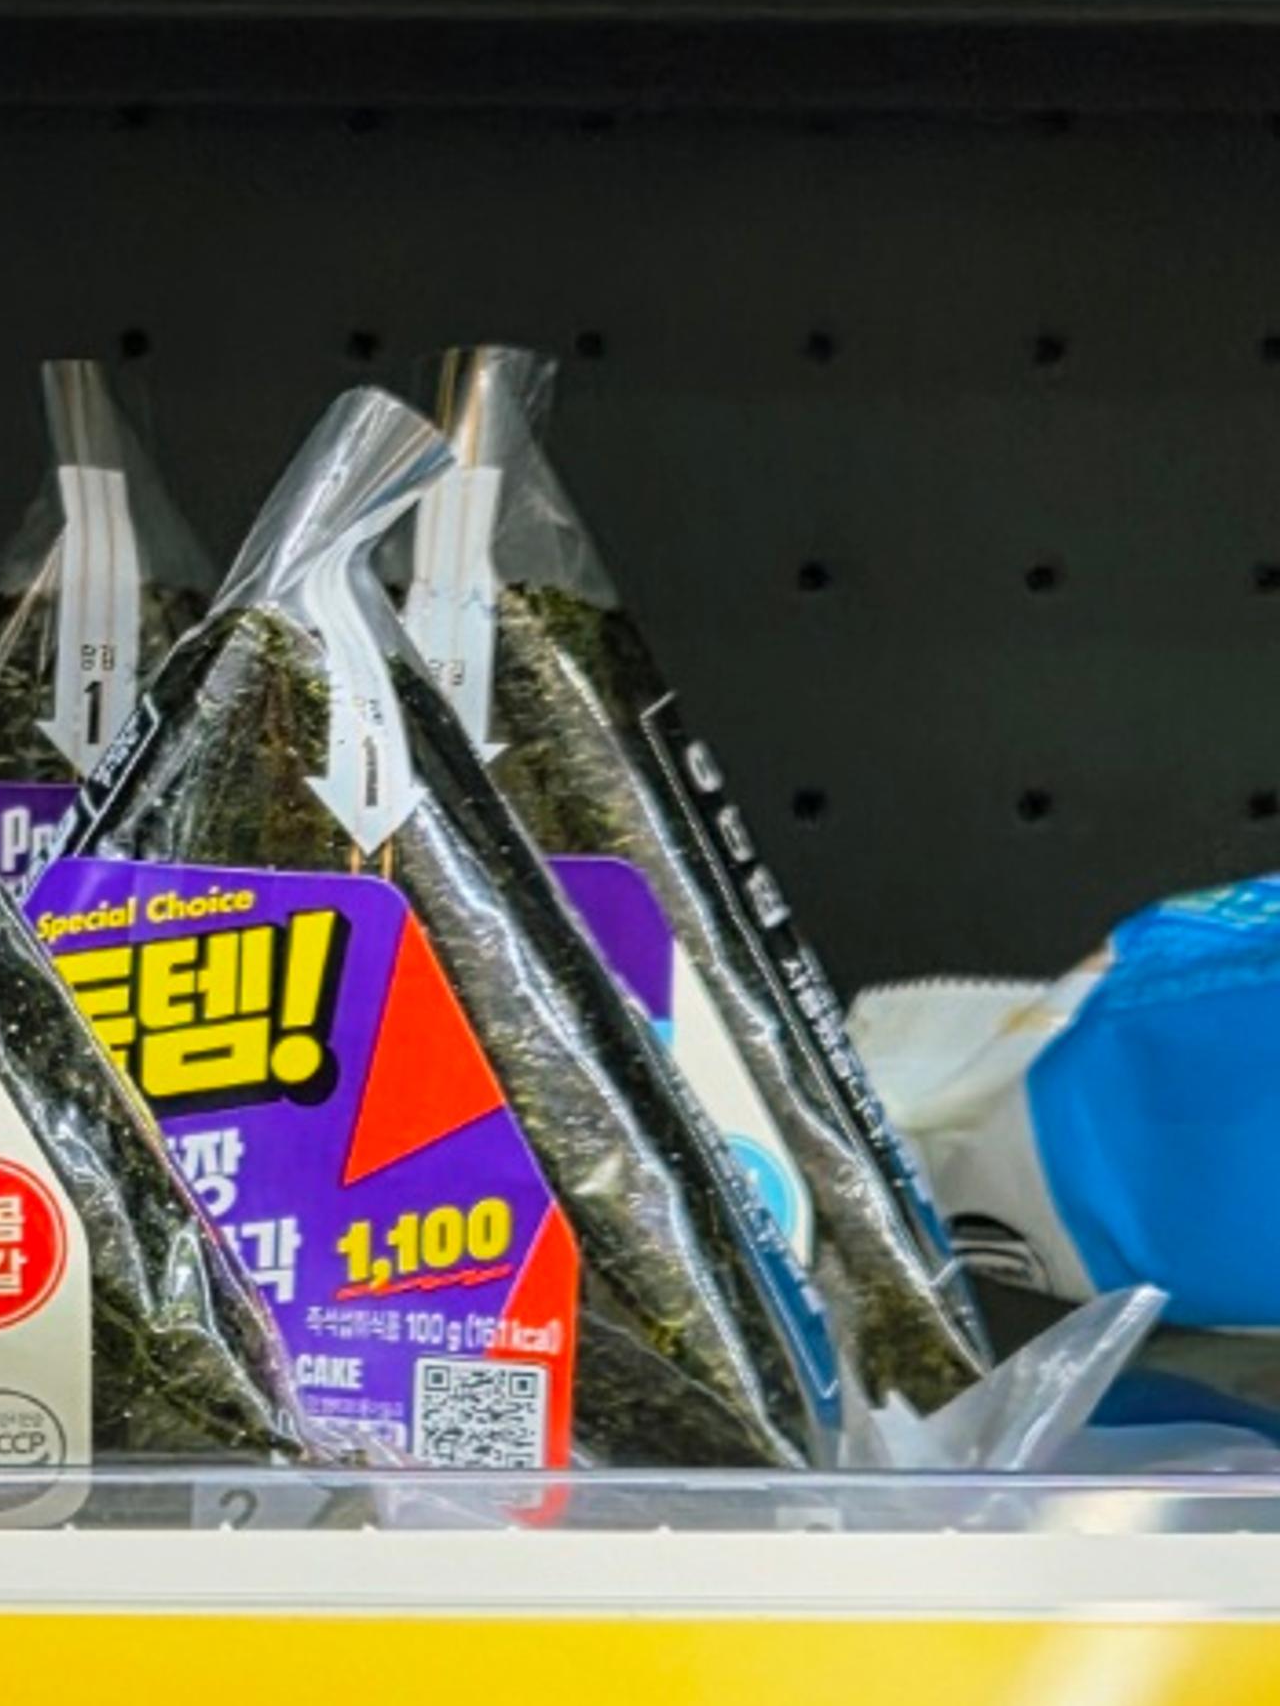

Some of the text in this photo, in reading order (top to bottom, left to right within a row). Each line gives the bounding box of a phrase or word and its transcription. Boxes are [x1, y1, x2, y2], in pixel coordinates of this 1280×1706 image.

[84, 680, 103, 745] 1
[36, 886, 255, 939] Special Choice
[223, 1215, 303, 1303] 각
[336, 1196, 512, 1286] 1,100
[406, 1312, 445, 1345] 100
[446, 1320, 463, 1351] g
[510, 1319, 564, 1355] kcal)
[295, 1354, 364, 1391] CAKE
